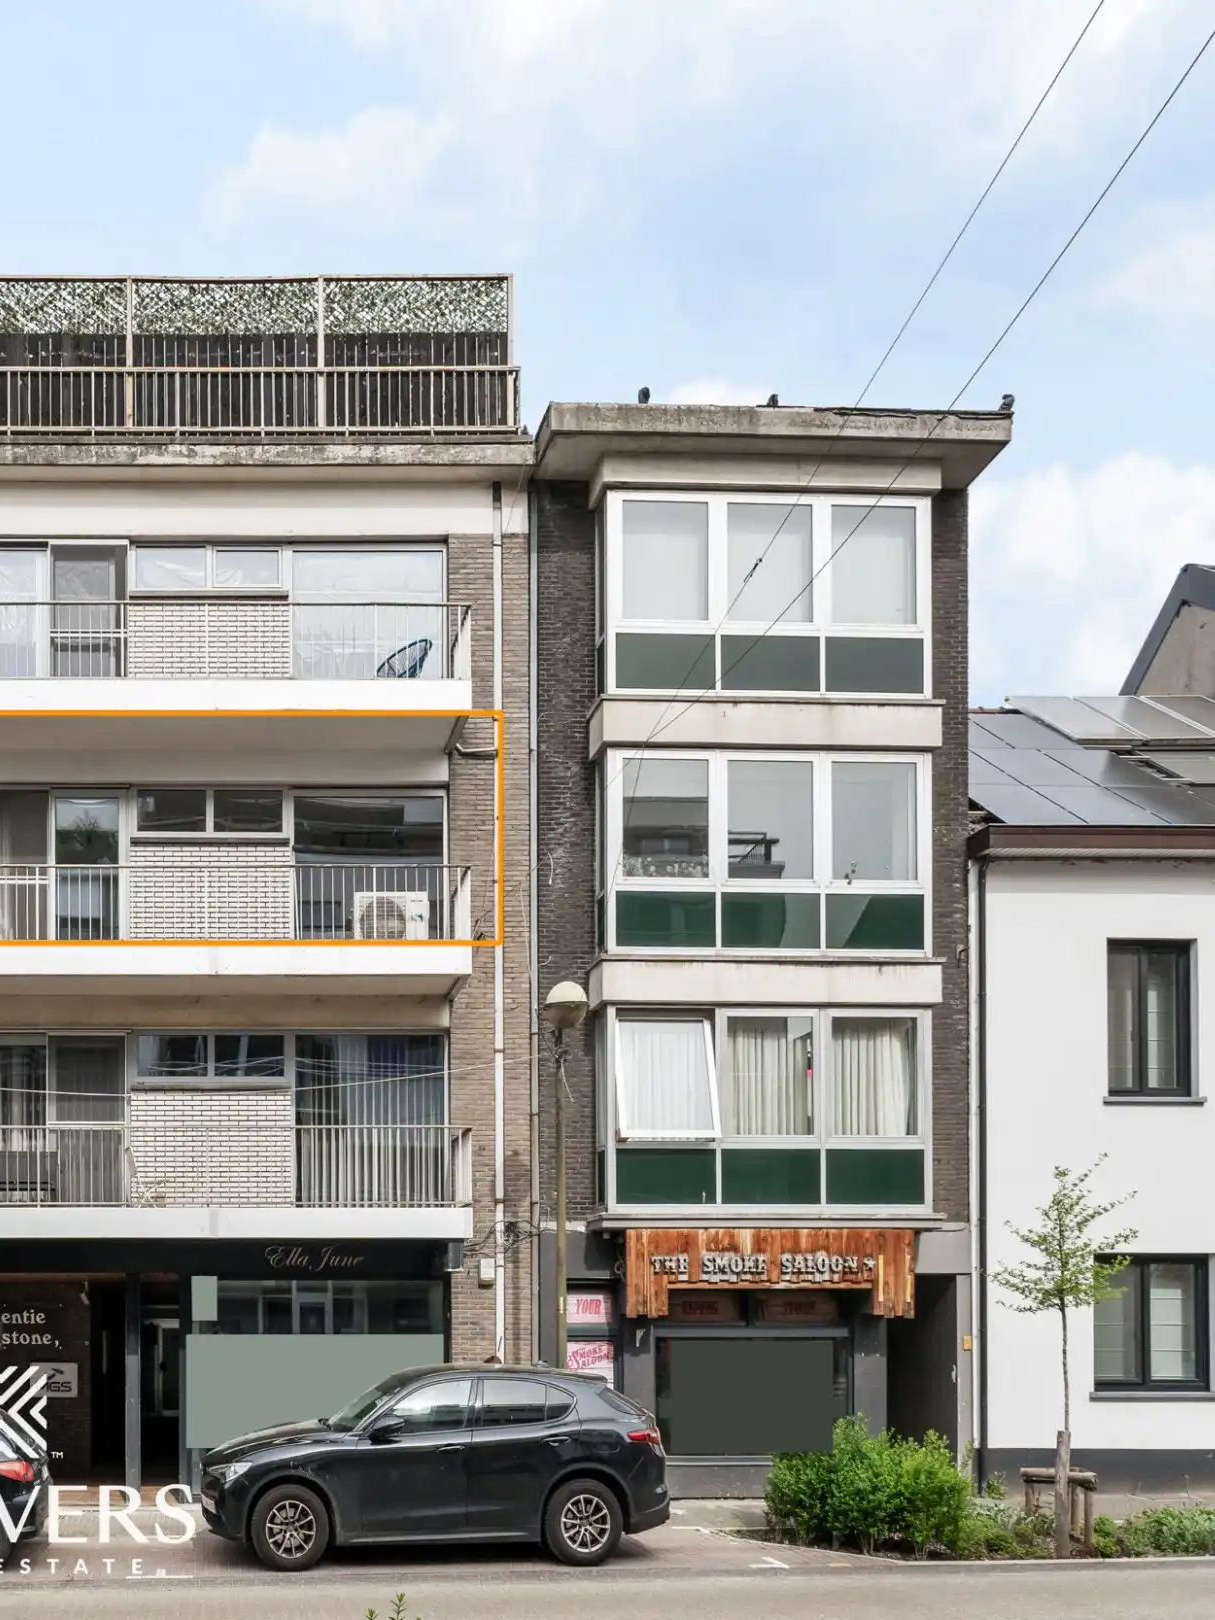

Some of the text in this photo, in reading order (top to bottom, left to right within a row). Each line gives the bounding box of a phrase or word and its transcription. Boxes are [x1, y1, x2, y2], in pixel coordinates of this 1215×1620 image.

[264, 1244, 310, 1269] Ella
[650, 1253, 858, 1273] THE SMOKE SALOON
[574, 1298, 603, 1315] YOUR
